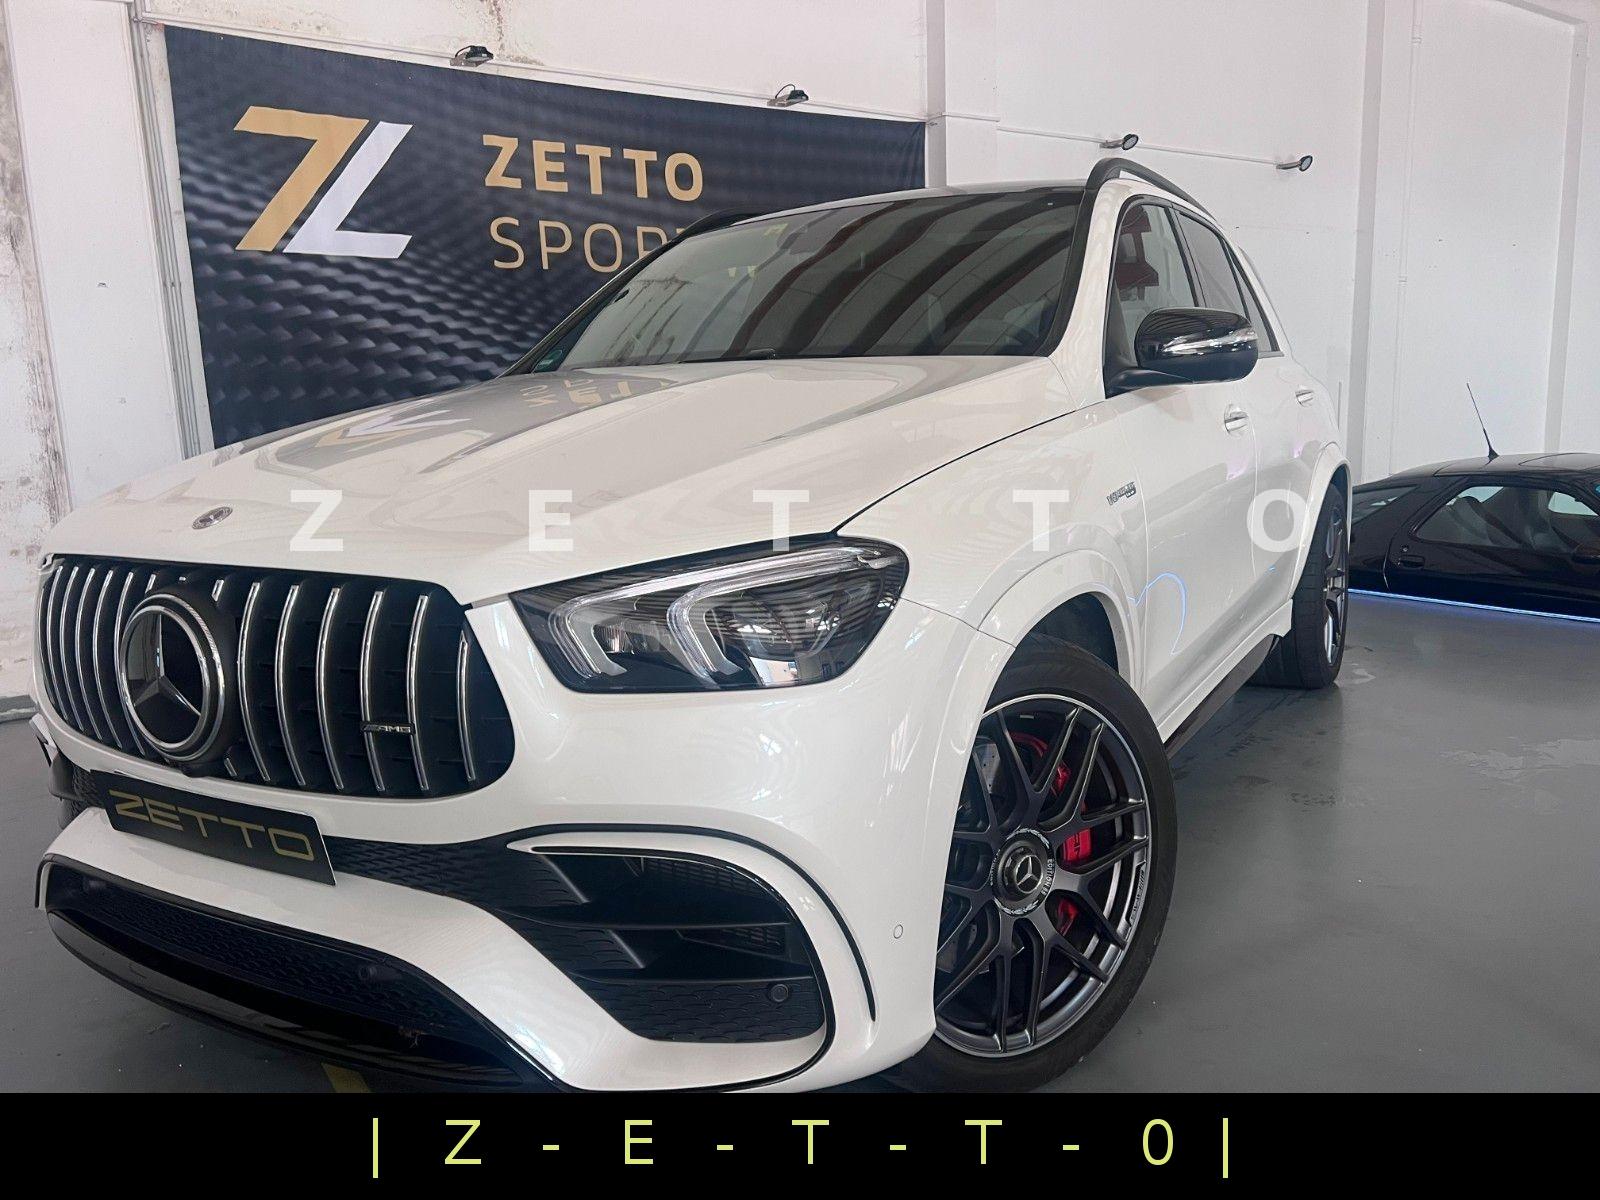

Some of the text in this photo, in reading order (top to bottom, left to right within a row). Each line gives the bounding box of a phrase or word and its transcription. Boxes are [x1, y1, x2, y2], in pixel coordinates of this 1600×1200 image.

[482, 134, 703, 201] ZETTO
[490, 216, 687, 273] SPOR
[108, 789, 314, 861] ZETTO
